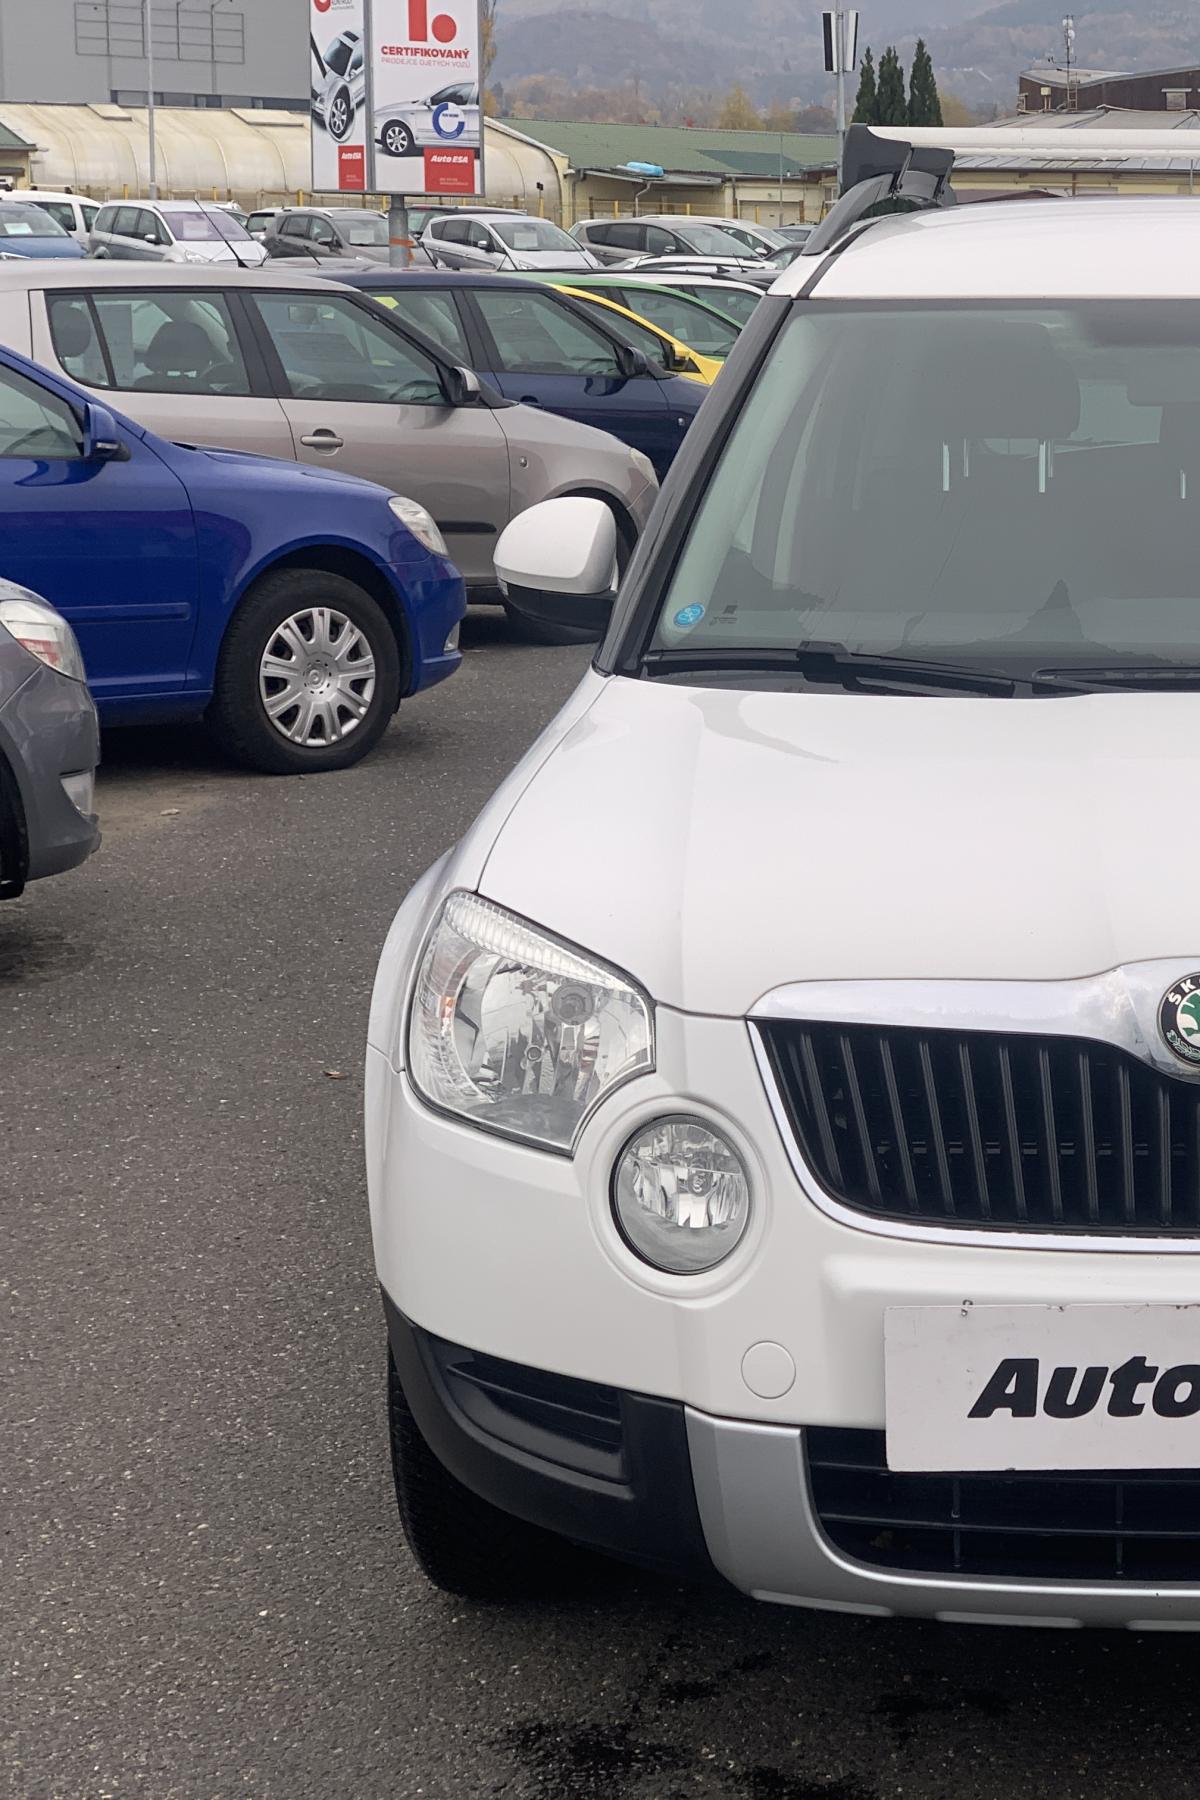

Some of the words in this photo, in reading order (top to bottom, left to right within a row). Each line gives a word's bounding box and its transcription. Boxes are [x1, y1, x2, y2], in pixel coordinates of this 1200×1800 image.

[381, 46, 470, 59] CERTIFIKOVANÝ
[431, 155, 452, 164] Auto
[452, 155, 468, 164] ESA
